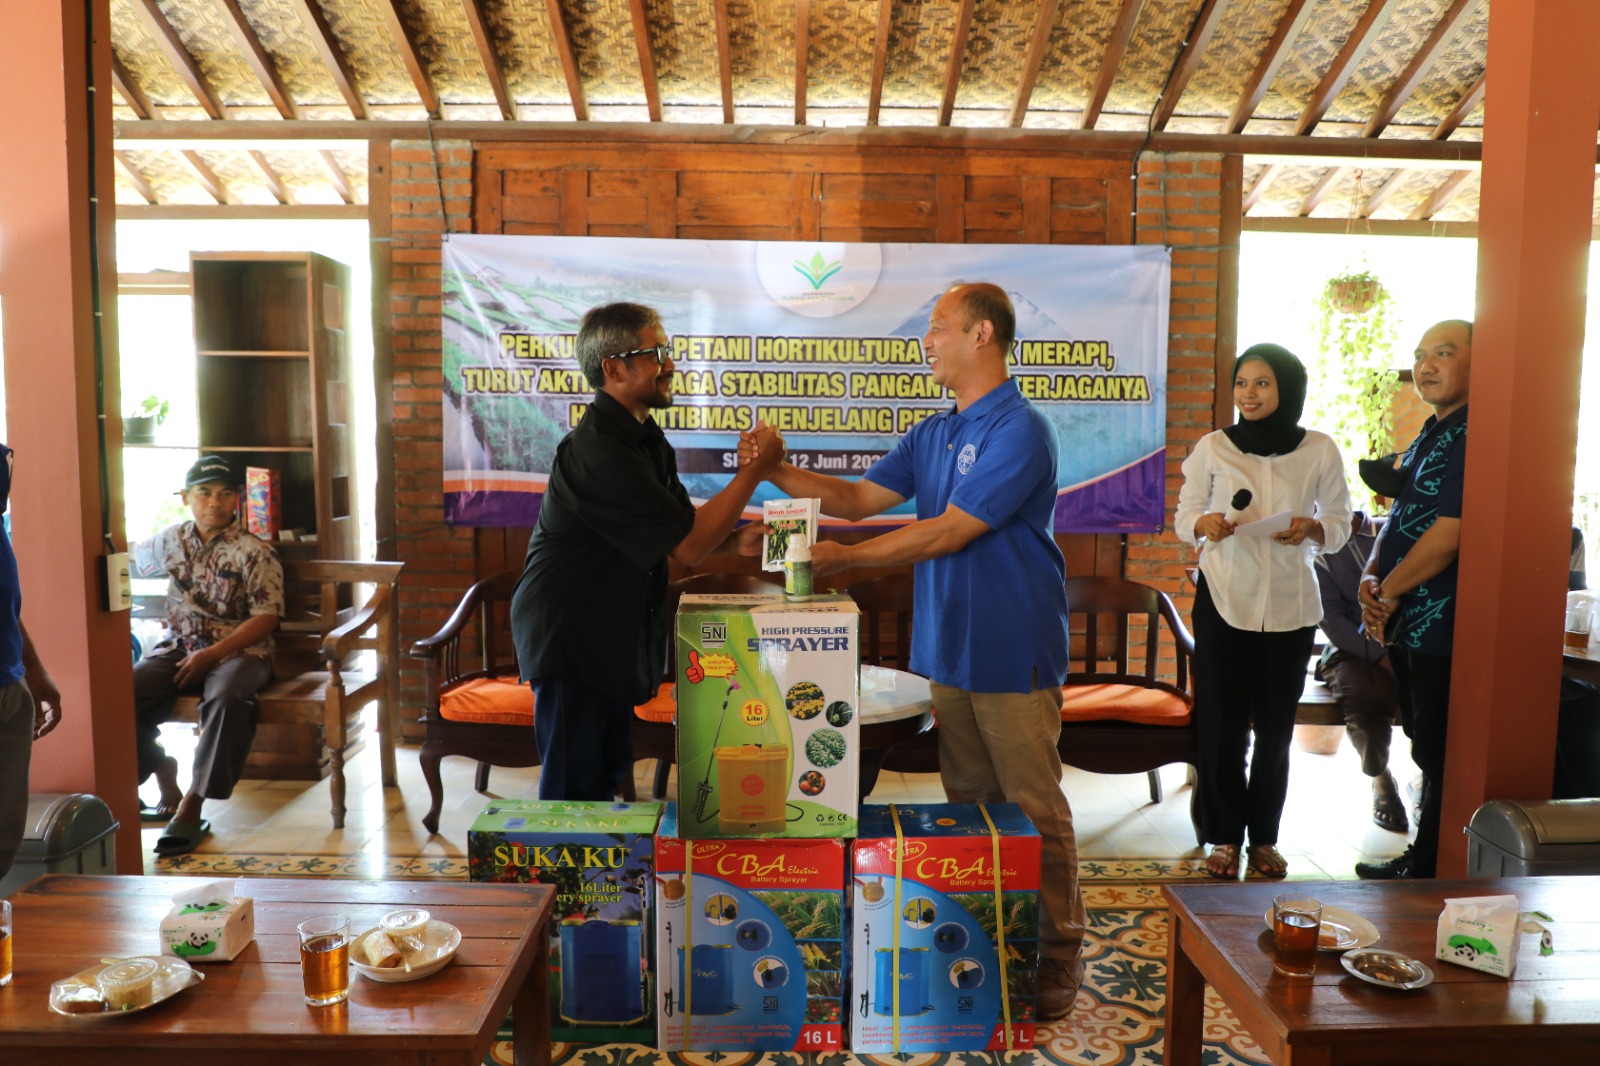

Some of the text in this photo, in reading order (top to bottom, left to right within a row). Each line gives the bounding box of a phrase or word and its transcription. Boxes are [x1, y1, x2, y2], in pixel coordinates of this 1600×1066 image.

[500, 334, 578, 360] PERKU
[672, 336, 751, 362] PETANI
[756, 336, 923, 364] HORTIKULTURA
[1021, 341, 1115, 371] MERAPI,
[462, 367, 535, 393] TURUT
[537, 369, 595, 394] AKTI
[671, 370, 717, 396] AGA
[720, 371, 846, 398] STABILITAS
[851, 373, 942, 399] PANGAN
[651, 405, 752, 431] MTIBMAS
[757, 406, 893, 432] MENJELANG
[790, 453, 809, 469] 12
[813, 453, 848, 469] Juni
[702, 626, 726, 640] SNI
[761, 626, 849, 635] HIGH PRESSURE
[747, 637, 849, 652] SPRAYER
[745, 705, 763, 715] 16
[697, 844, 720, 853] ULTRA
[716, 853, 819, 876] CBA Electric
[916, 856, 985, 880] CBA
[751, 876, 808, 884] Battery Sprayer
[950, 879, 976, 887] Battery
[556, 893, 623, 904] ery sprayer
[958, 999, 973, 1009] SNI
[803, 1031, 822, 1044] 16
[827, 1031, 837, 1044] L
[1019, 1030, 1029, 1043] L
